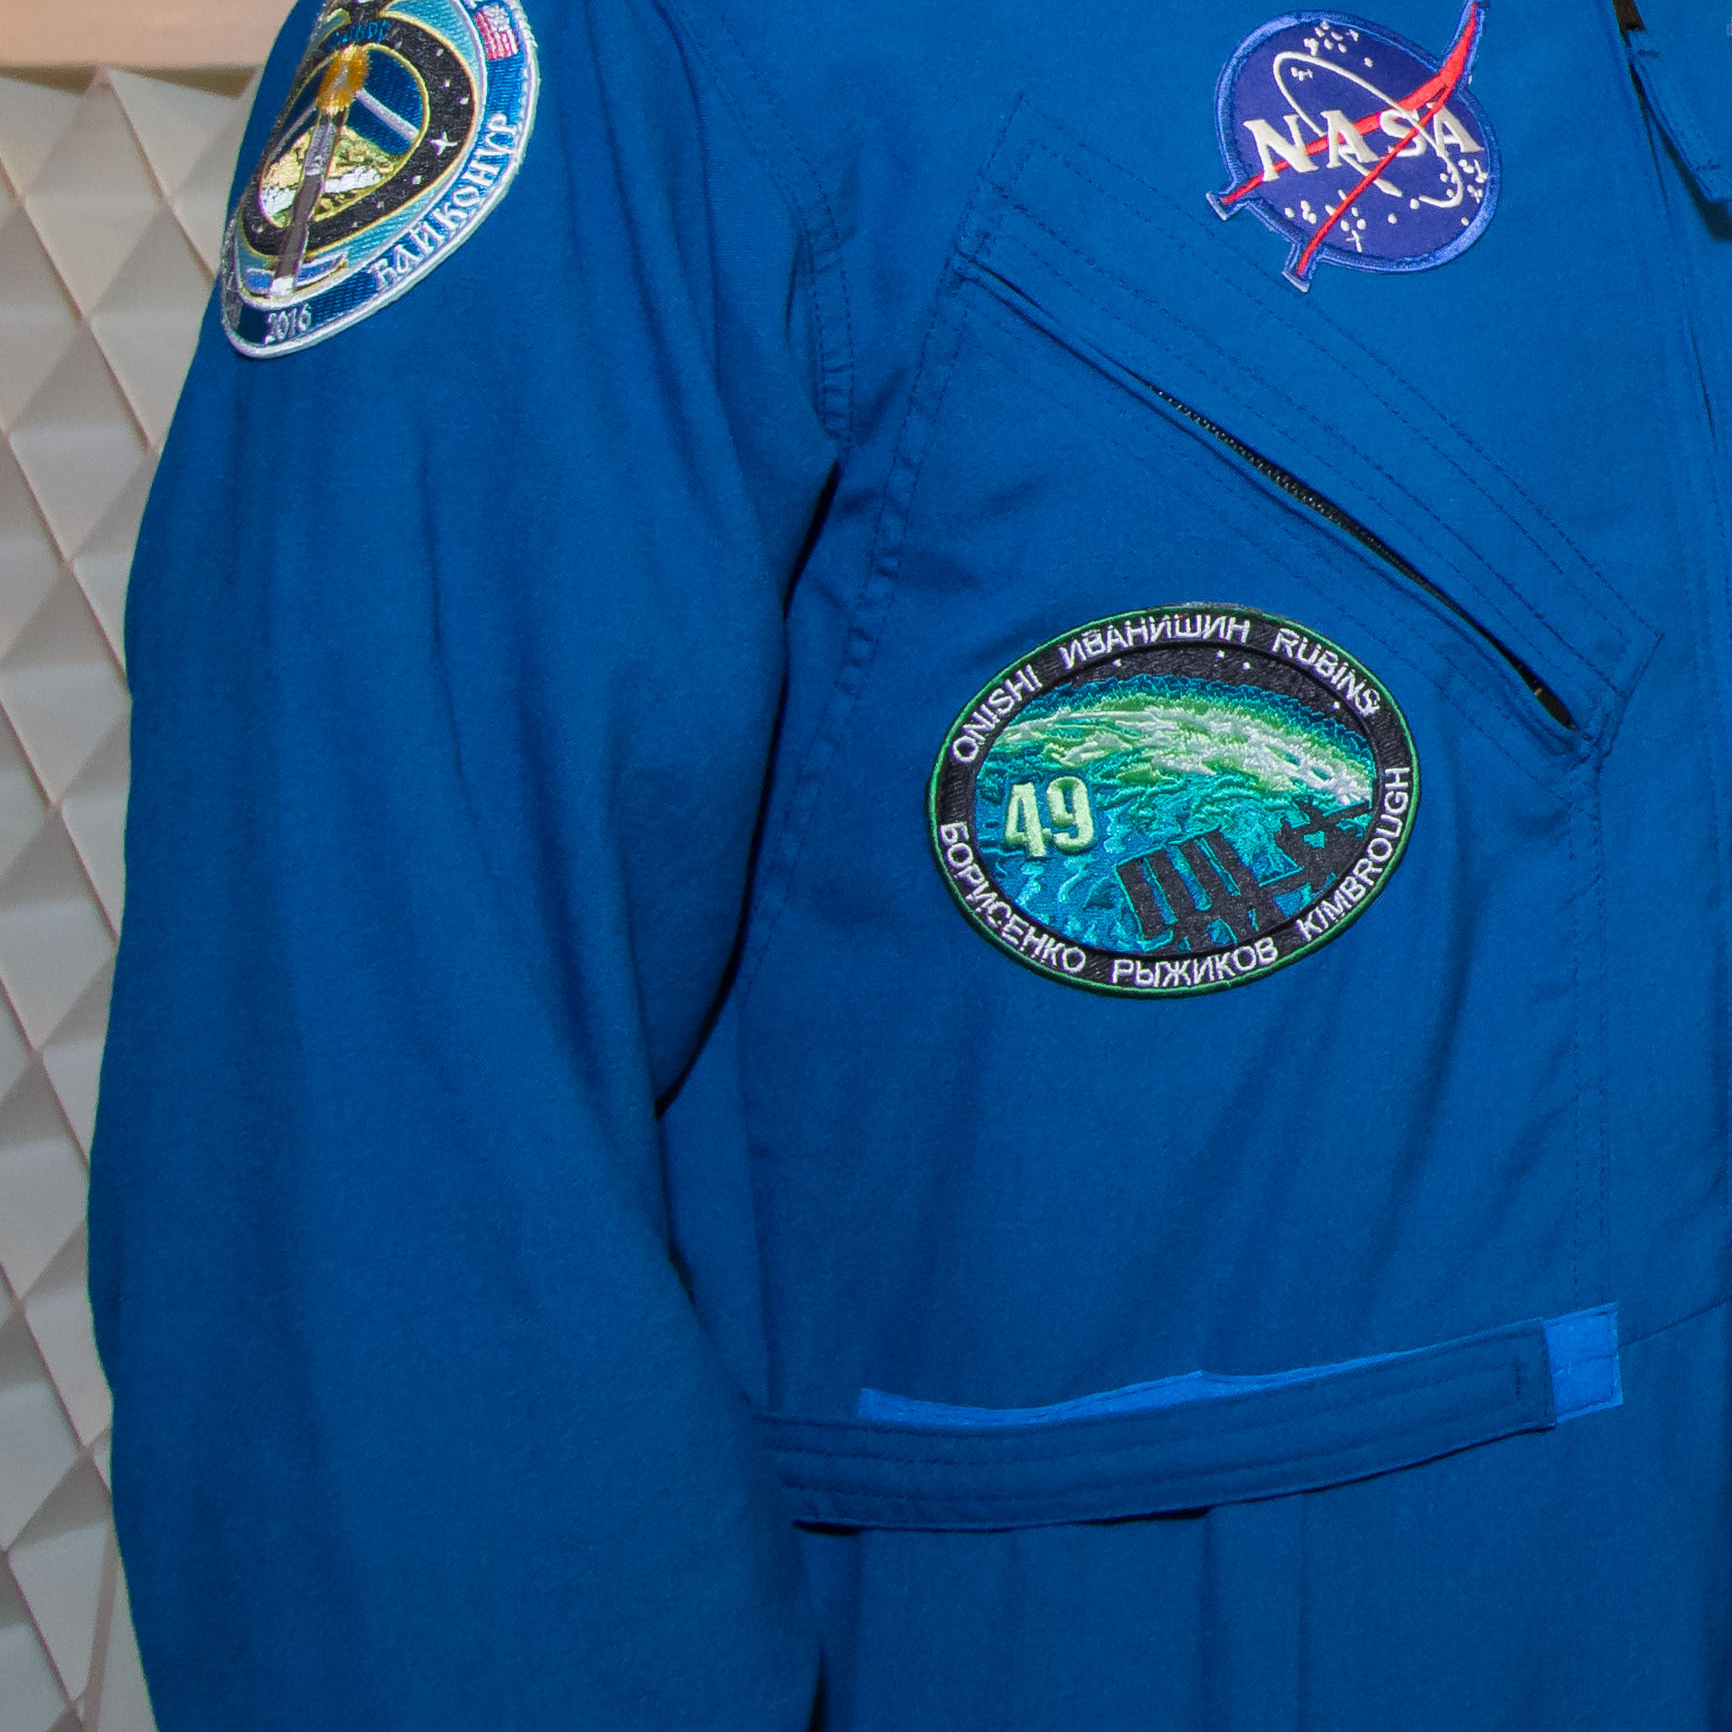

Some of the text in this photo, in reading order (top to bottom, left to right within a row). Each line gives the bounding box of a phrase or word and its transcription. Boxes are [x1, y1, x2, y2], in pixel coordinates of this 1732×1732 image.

[1243, 100, 1485, 183] NASA
[951, 613, 1381, 765] ONISHI ИВАНИШИН RUBINS
[1003, 775, 1096, 858] 49
[939, 767, 1412, 990] БОРИСЕНКО РЫЖИКОВ KIMBROUGH
